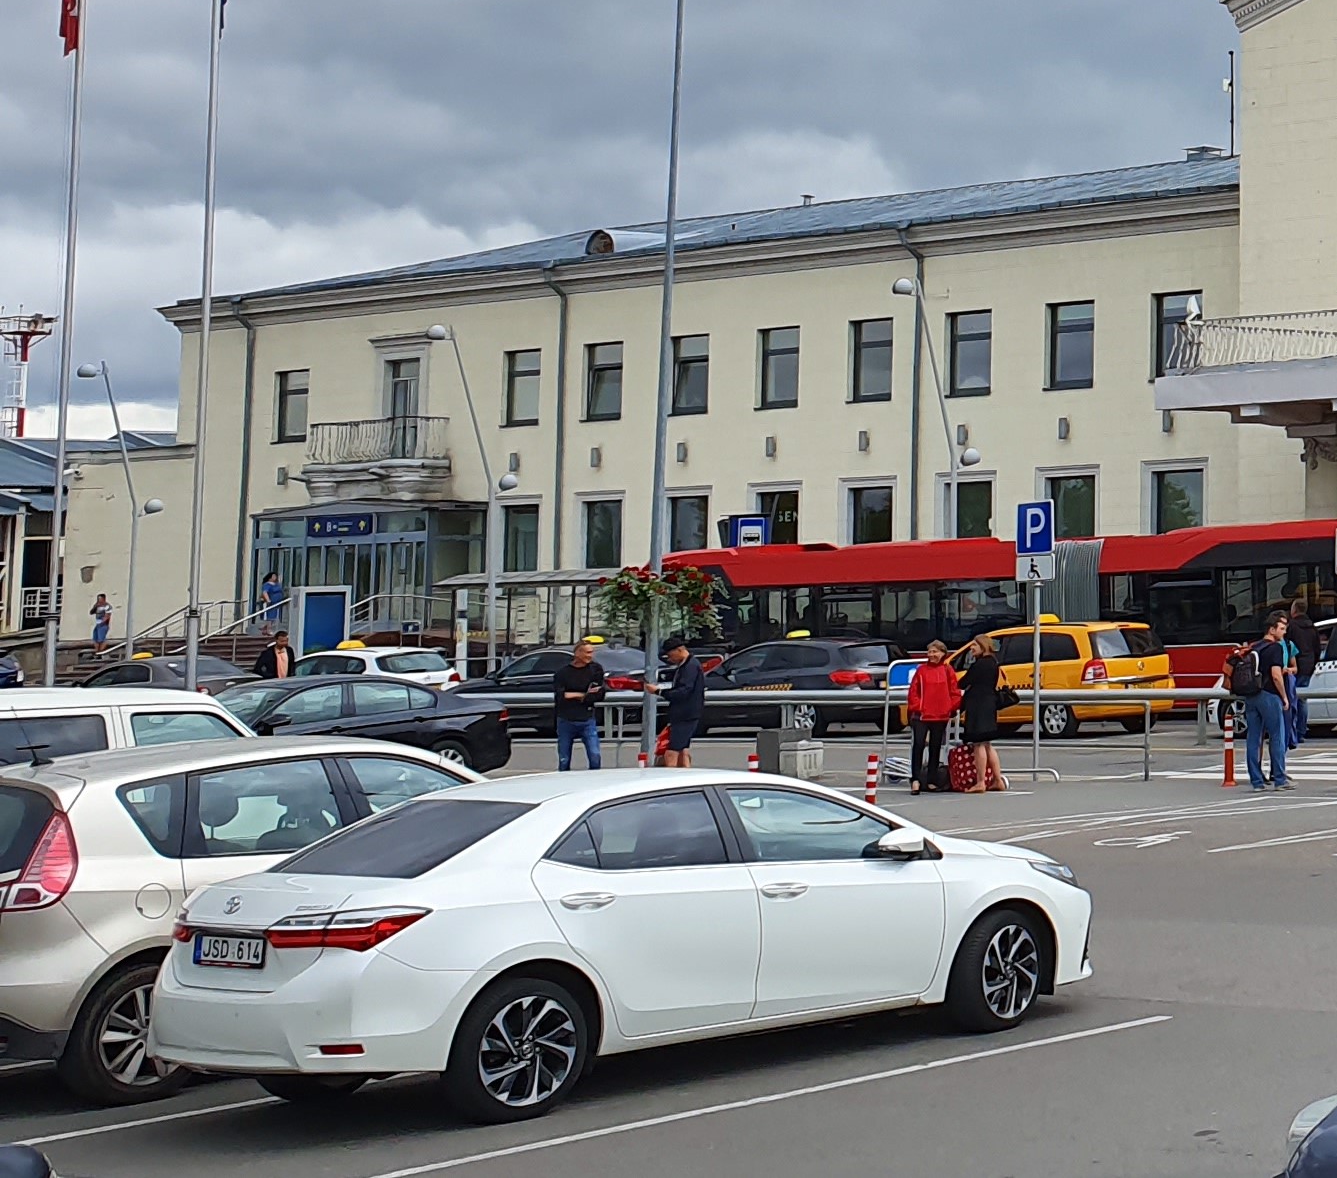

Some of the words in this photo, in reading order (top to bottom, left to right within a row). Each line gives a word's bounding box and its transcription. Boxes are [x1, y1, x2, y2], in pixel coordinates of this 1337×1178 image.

[1026, 507, 1046, 549] P
[202, 938, 230, 959] JSD
[236, 940, 260, 961] 614
